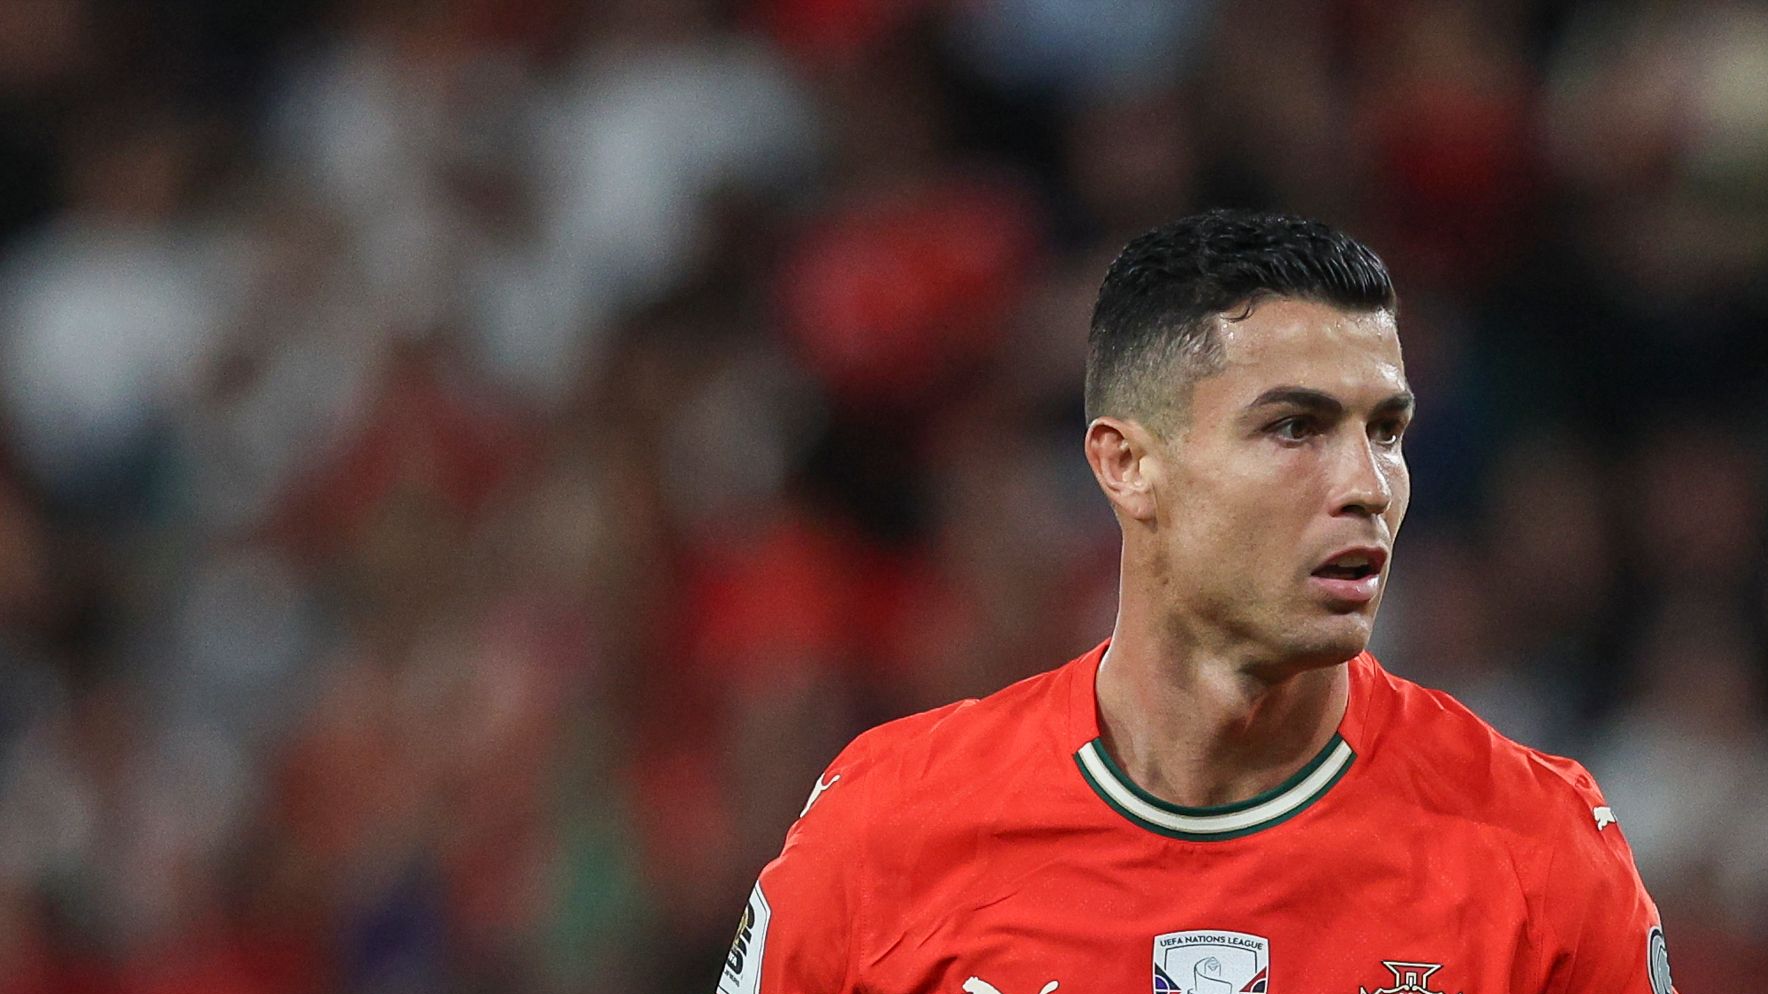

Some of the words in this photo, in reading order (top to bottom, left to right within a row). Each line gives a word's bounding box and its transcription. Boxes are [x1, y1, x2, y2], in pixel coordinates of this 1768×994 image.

[1160, 937, 1183, 947] UEFA
[1185, 935, 1226, 944] NATIONS
[1228, 936, 1264, 951] LEAGUE
